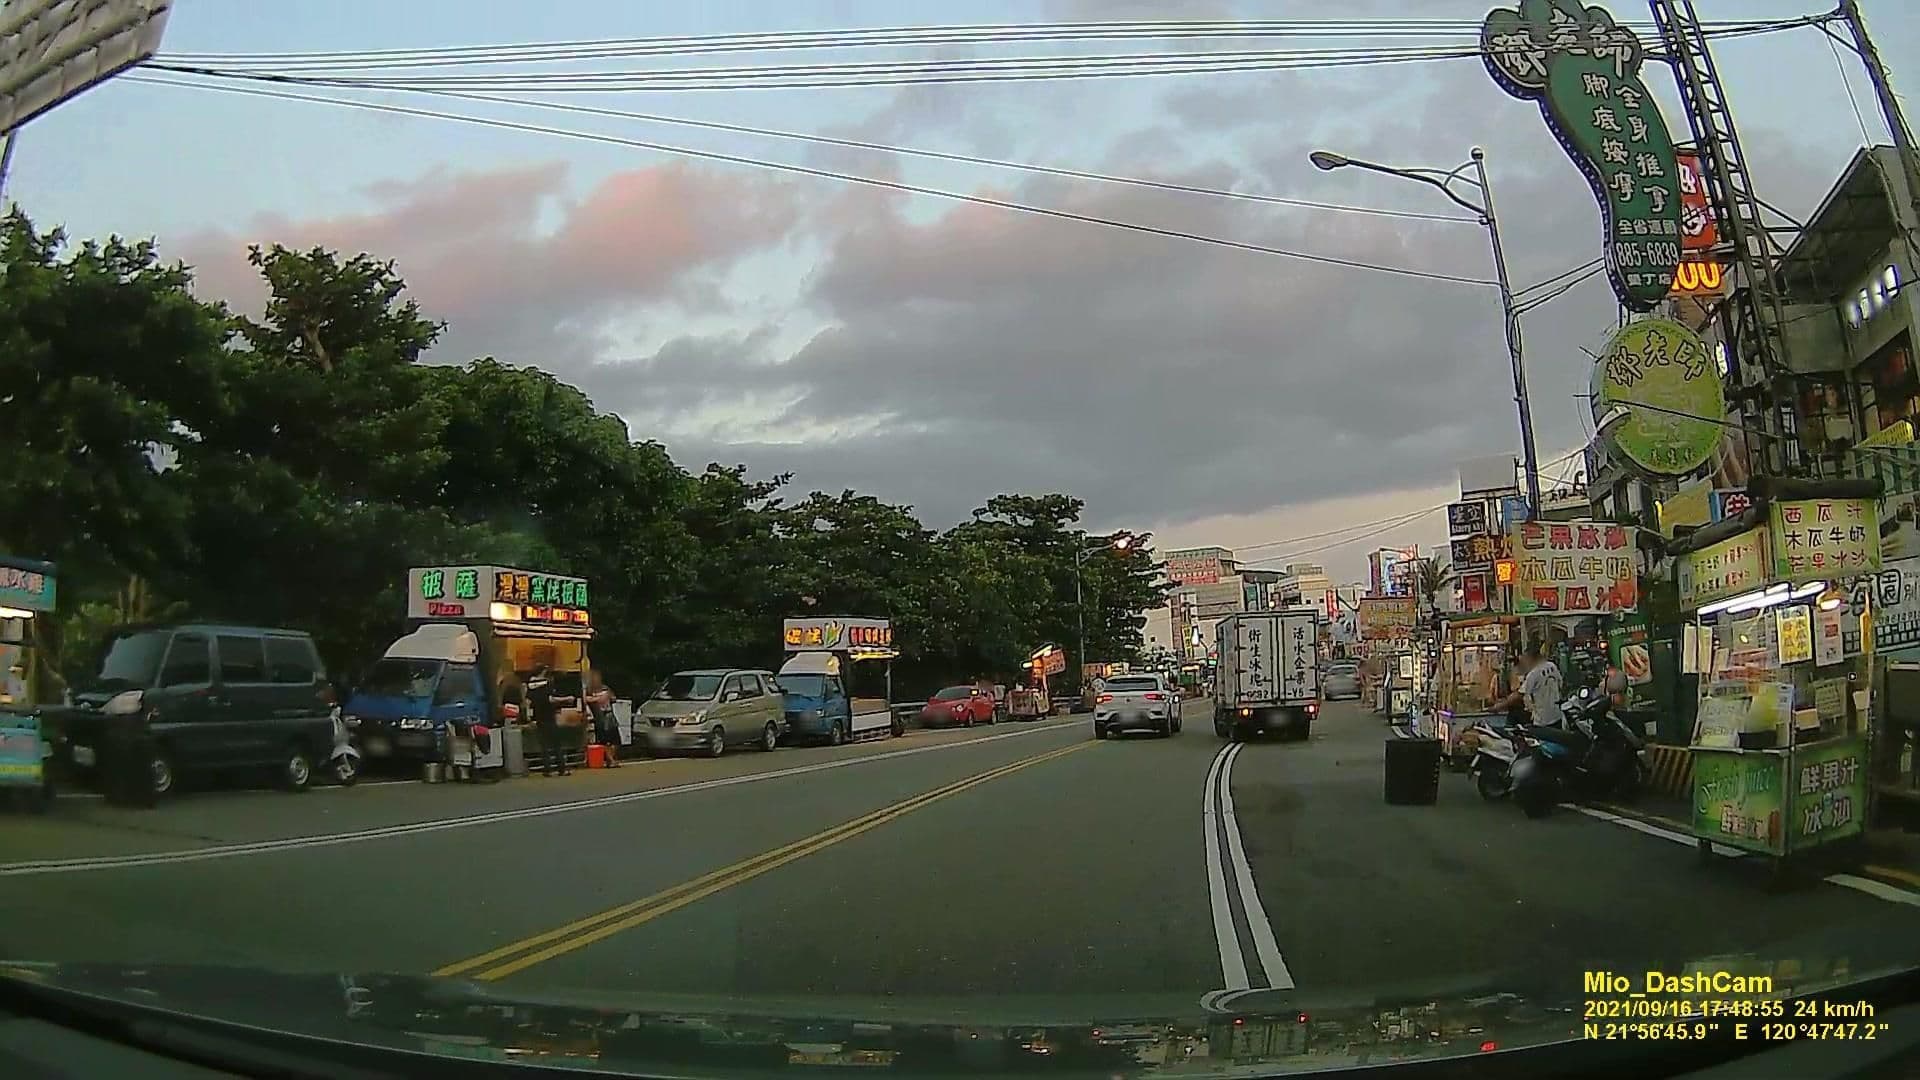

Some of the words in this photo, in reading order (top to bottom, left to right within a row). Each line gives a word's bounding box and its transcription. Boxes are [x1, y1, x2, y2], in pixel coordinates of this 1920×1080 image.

[1615, 86, 1667, 212] 全身推拿
[1615, 242, 1680, 267] 885-6839
[1784, 503, 1863, 524] 西瓜汁
[1785, 526, 1866, 550] 木瓜牛奶
[1521, 556, 1632, 581] 木瓜牛奶
[1787, 549, 1867, 573] 芒果冰沙
[422, 570, 478, 598] 披薩
[1799, 758, 1859, 795] 鮮果汁
